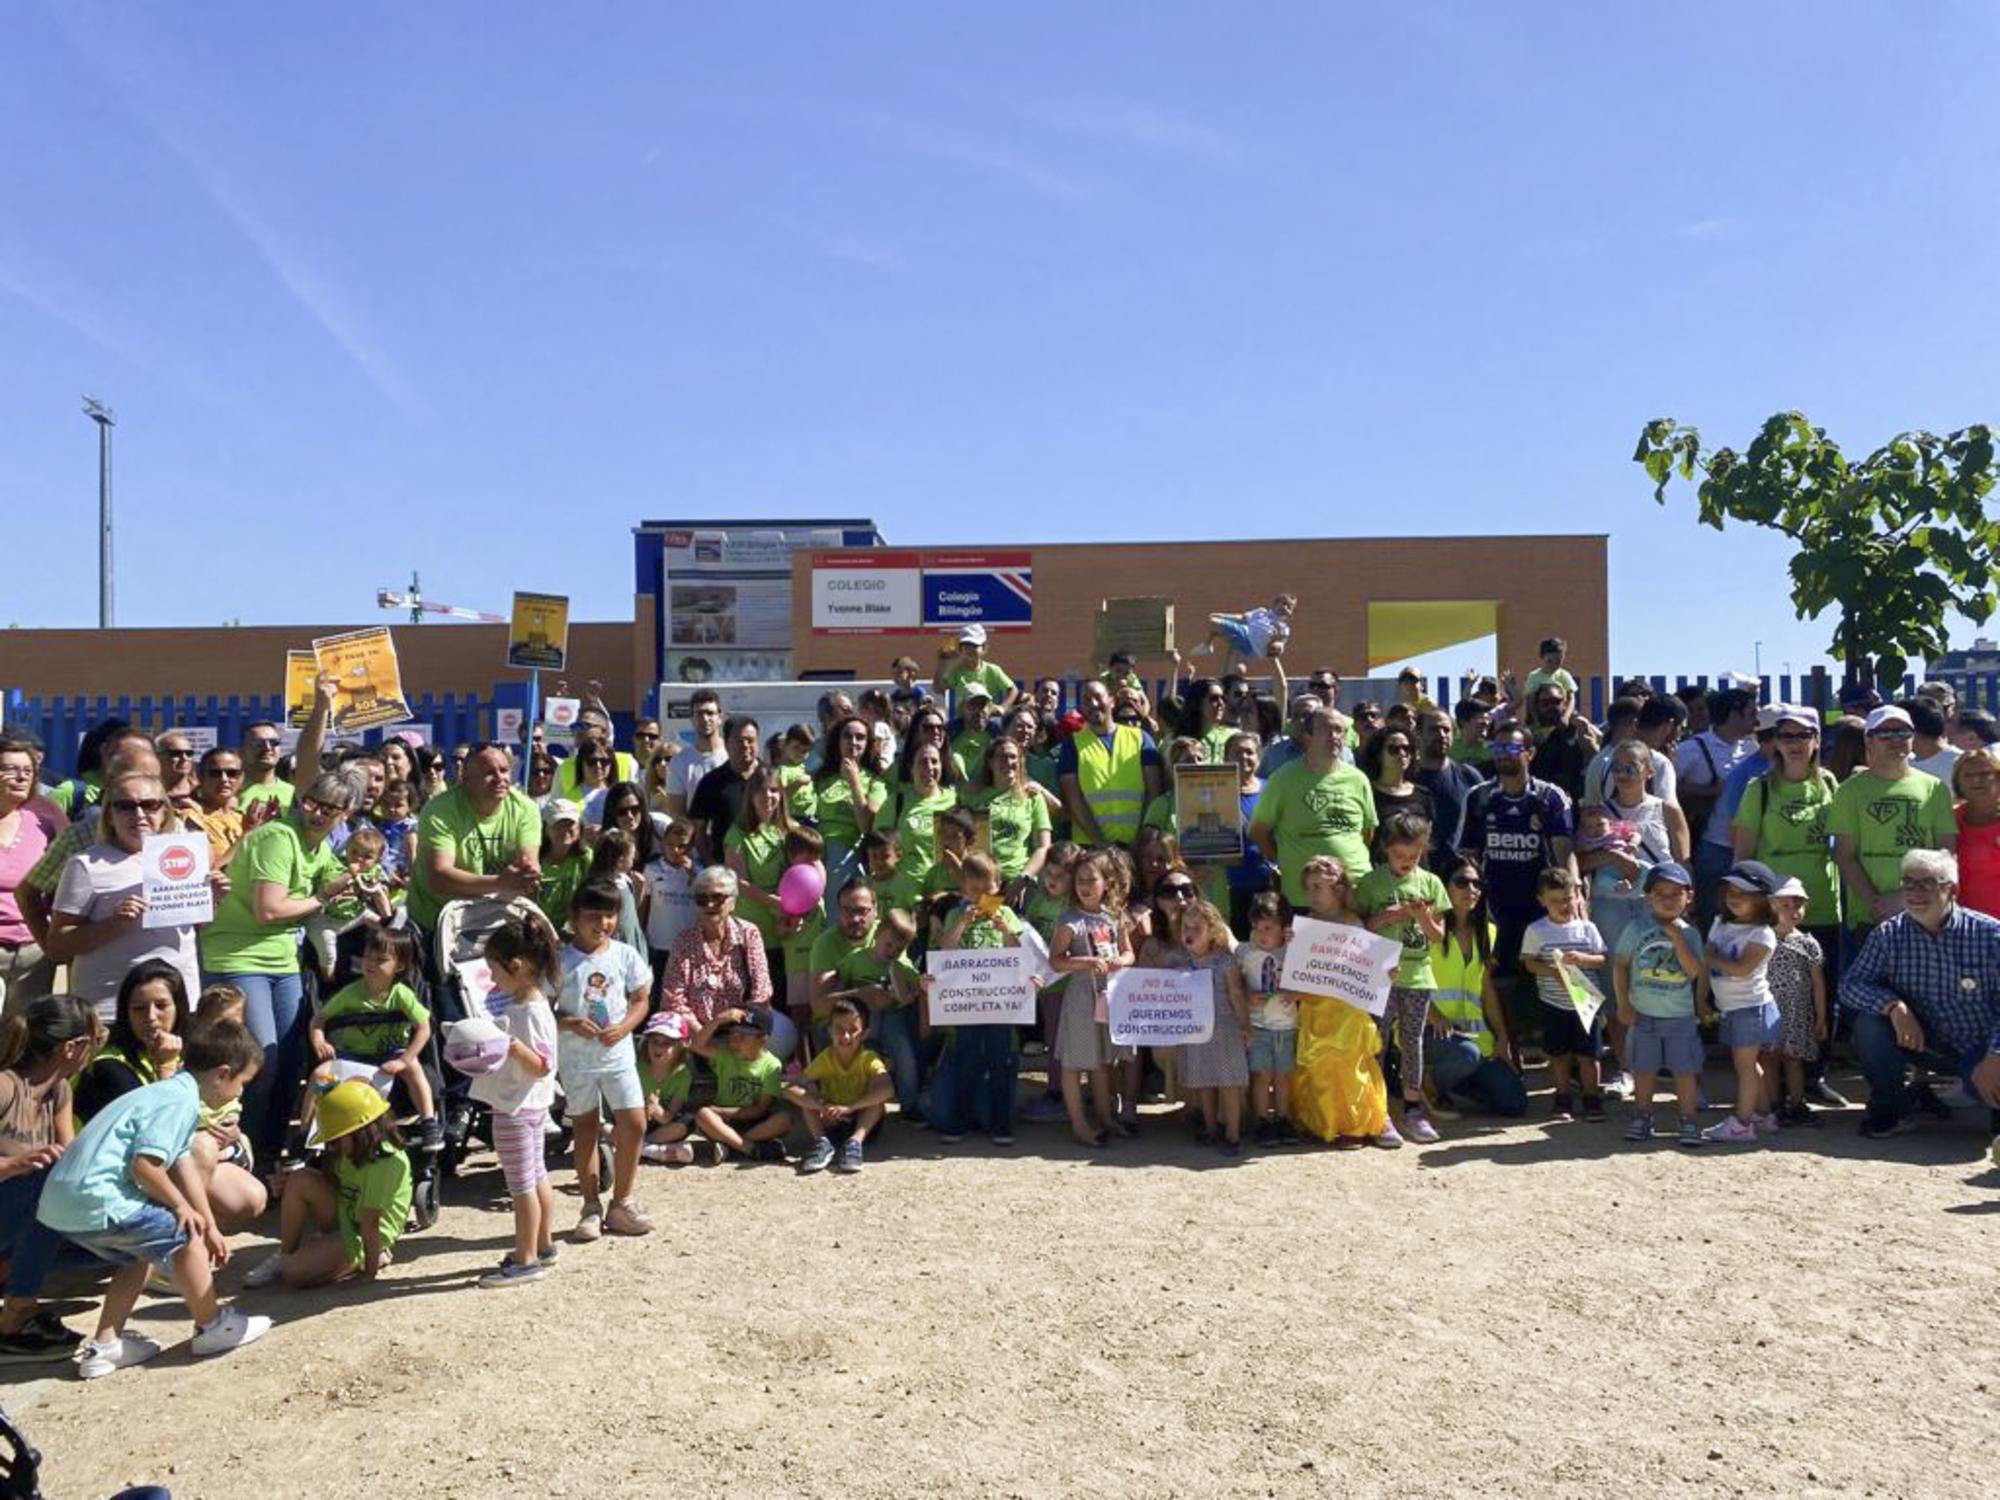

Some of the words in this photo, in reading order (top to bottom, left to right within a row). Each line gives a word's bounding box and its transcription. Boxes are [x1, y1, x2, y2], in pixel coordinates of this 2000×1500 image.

[827, 579, 886, 591] COLEGIO
[938, 591, 980, 605] Colegio
[828, 604, 863, 614] Yvonne
[864, 603, 891, 613] Blake
[971, 971, 991, 983] NO!
[1306, 958, 1370, 984] ¡QUEREMOS
[1162, 978, 1176, 988] AL
[1291, 970, 1378, 1001] CONSTRUCCIÓN!
[944, 1001, 1002, 1013] COMPLETA
[1003, 1000, 1023, 1012] YA!
[1128, 1008, 1193, 1021] ¡QUEREMOS
